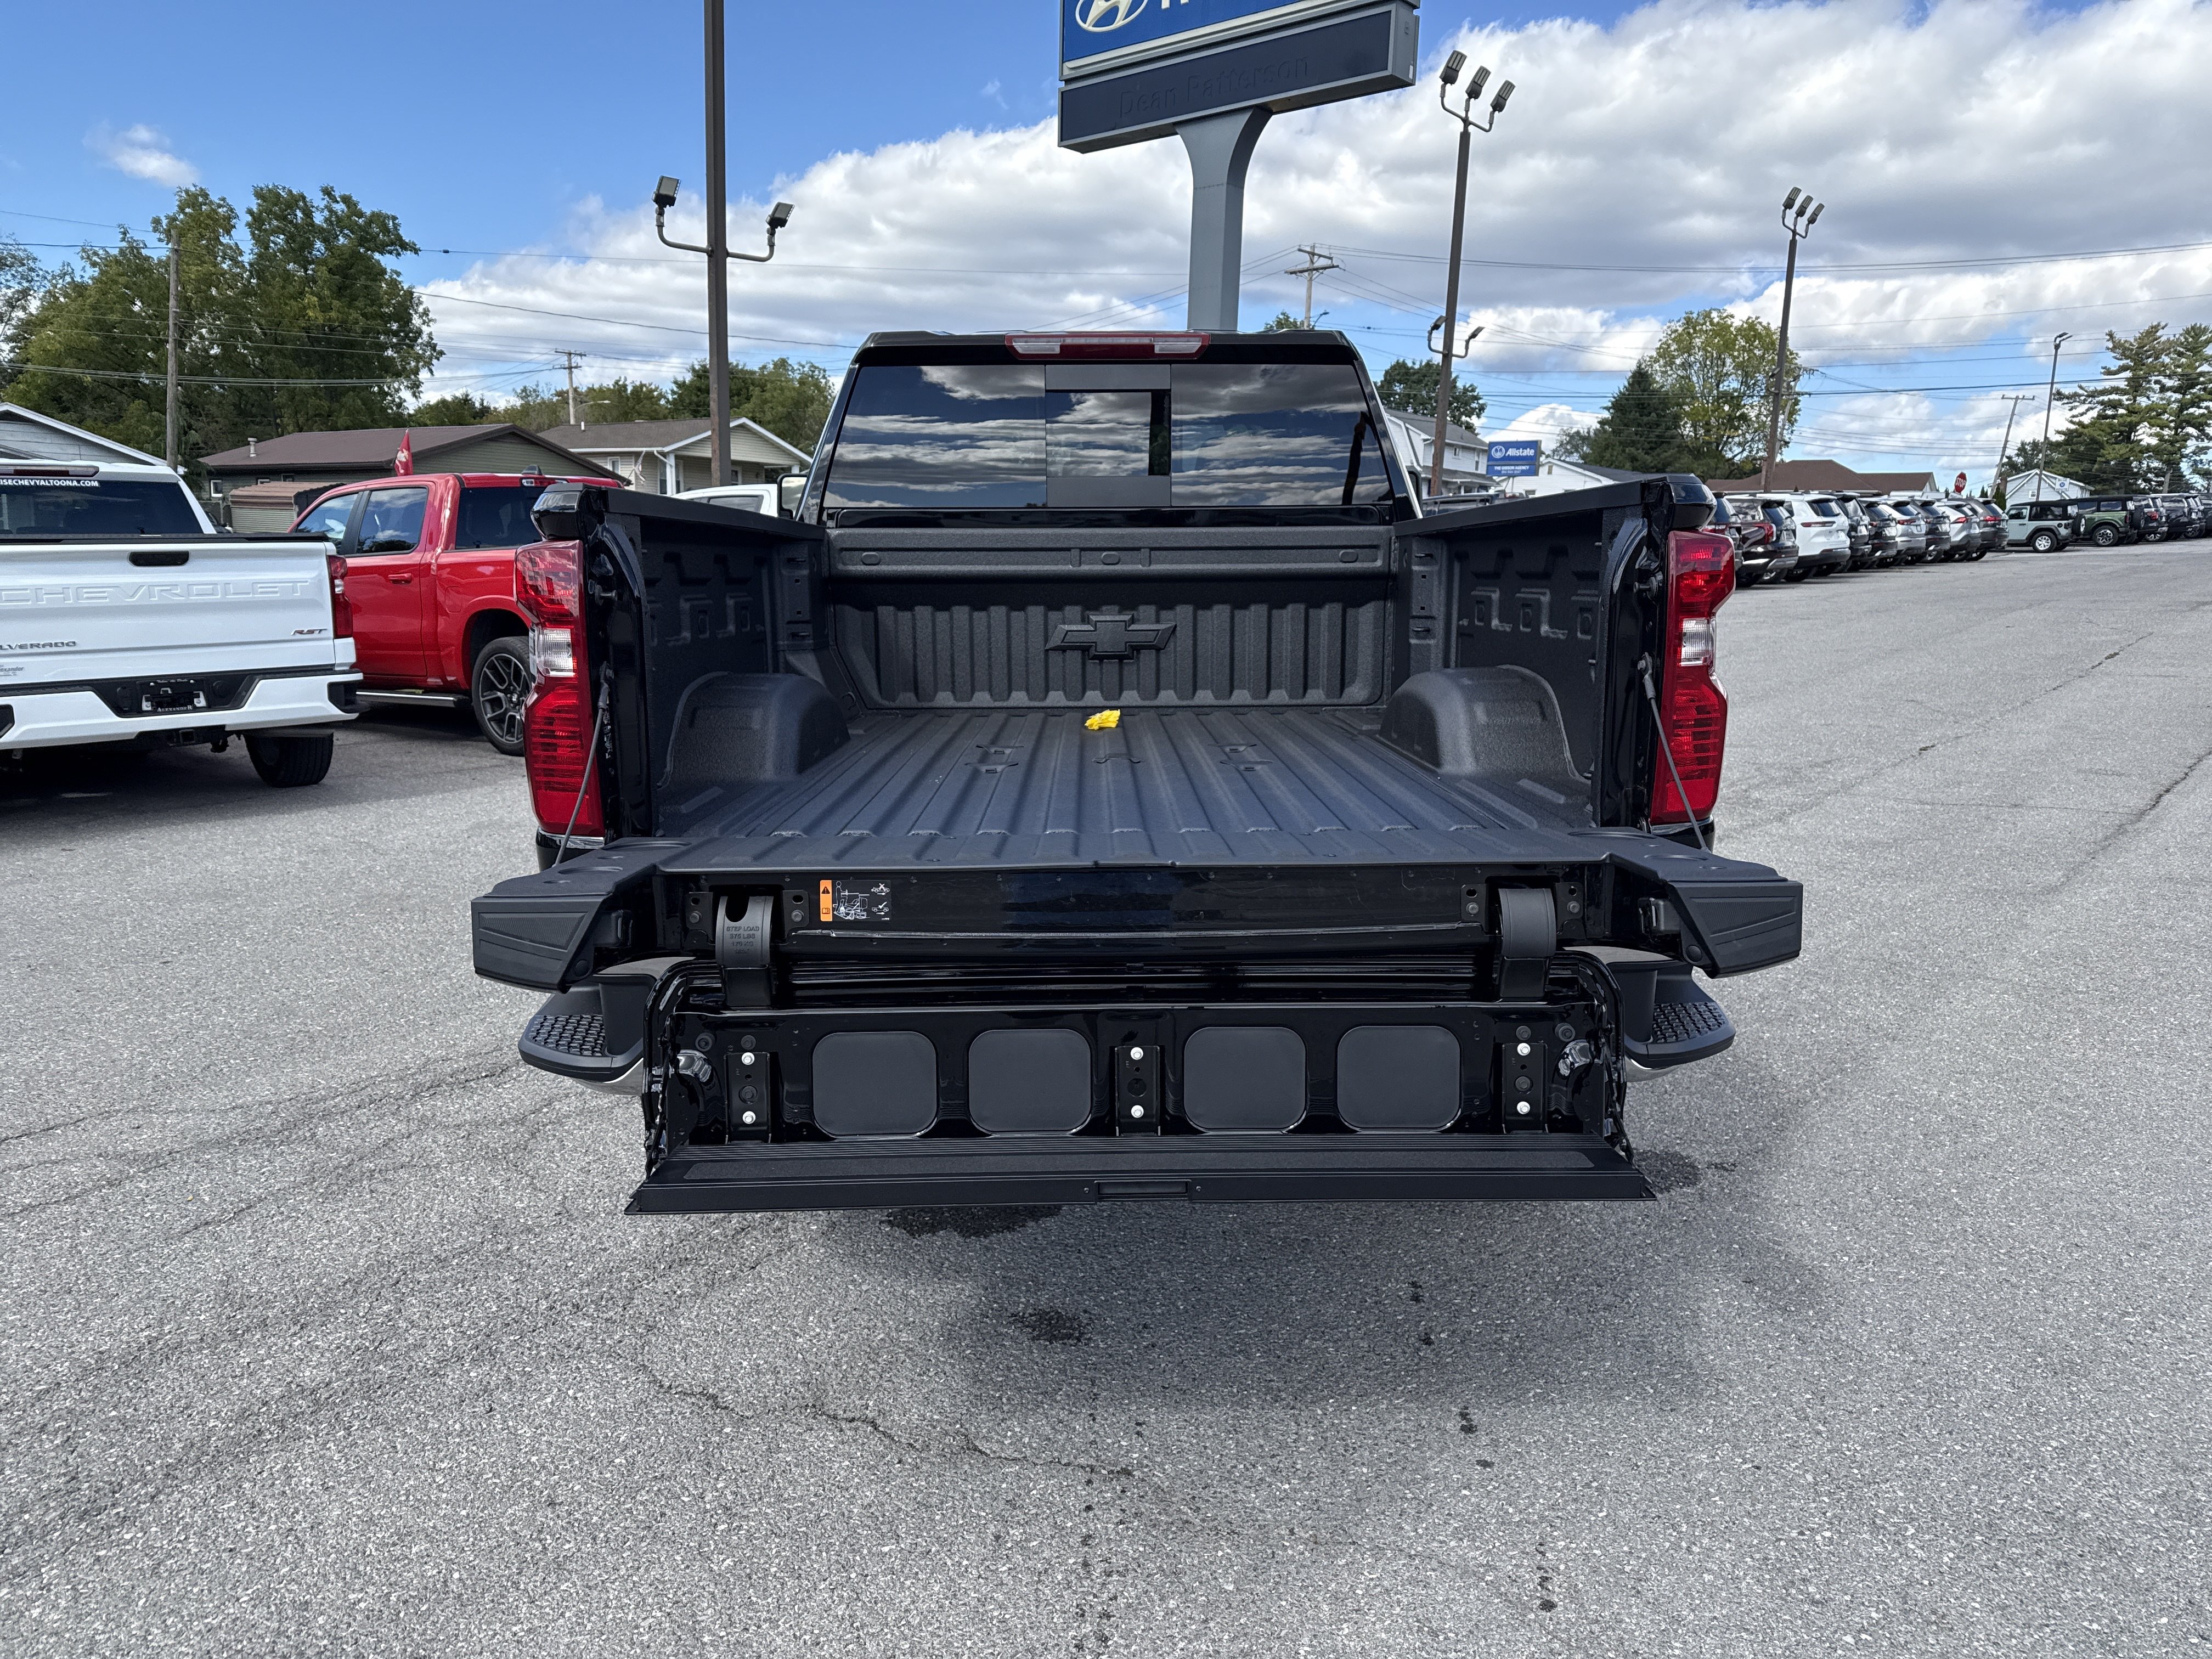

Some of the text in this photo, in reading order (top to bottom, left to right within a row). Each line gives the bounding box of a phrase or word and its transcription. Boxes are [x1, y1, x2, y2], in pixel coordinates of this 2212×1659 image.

[1120, 56, 1309, 119] Dean Patterson
[1505, 448, 1535, 456] Allstate
[1956, 477, 1966, 488] STOP
[0, 580, 309, 605] CHEVROLET
